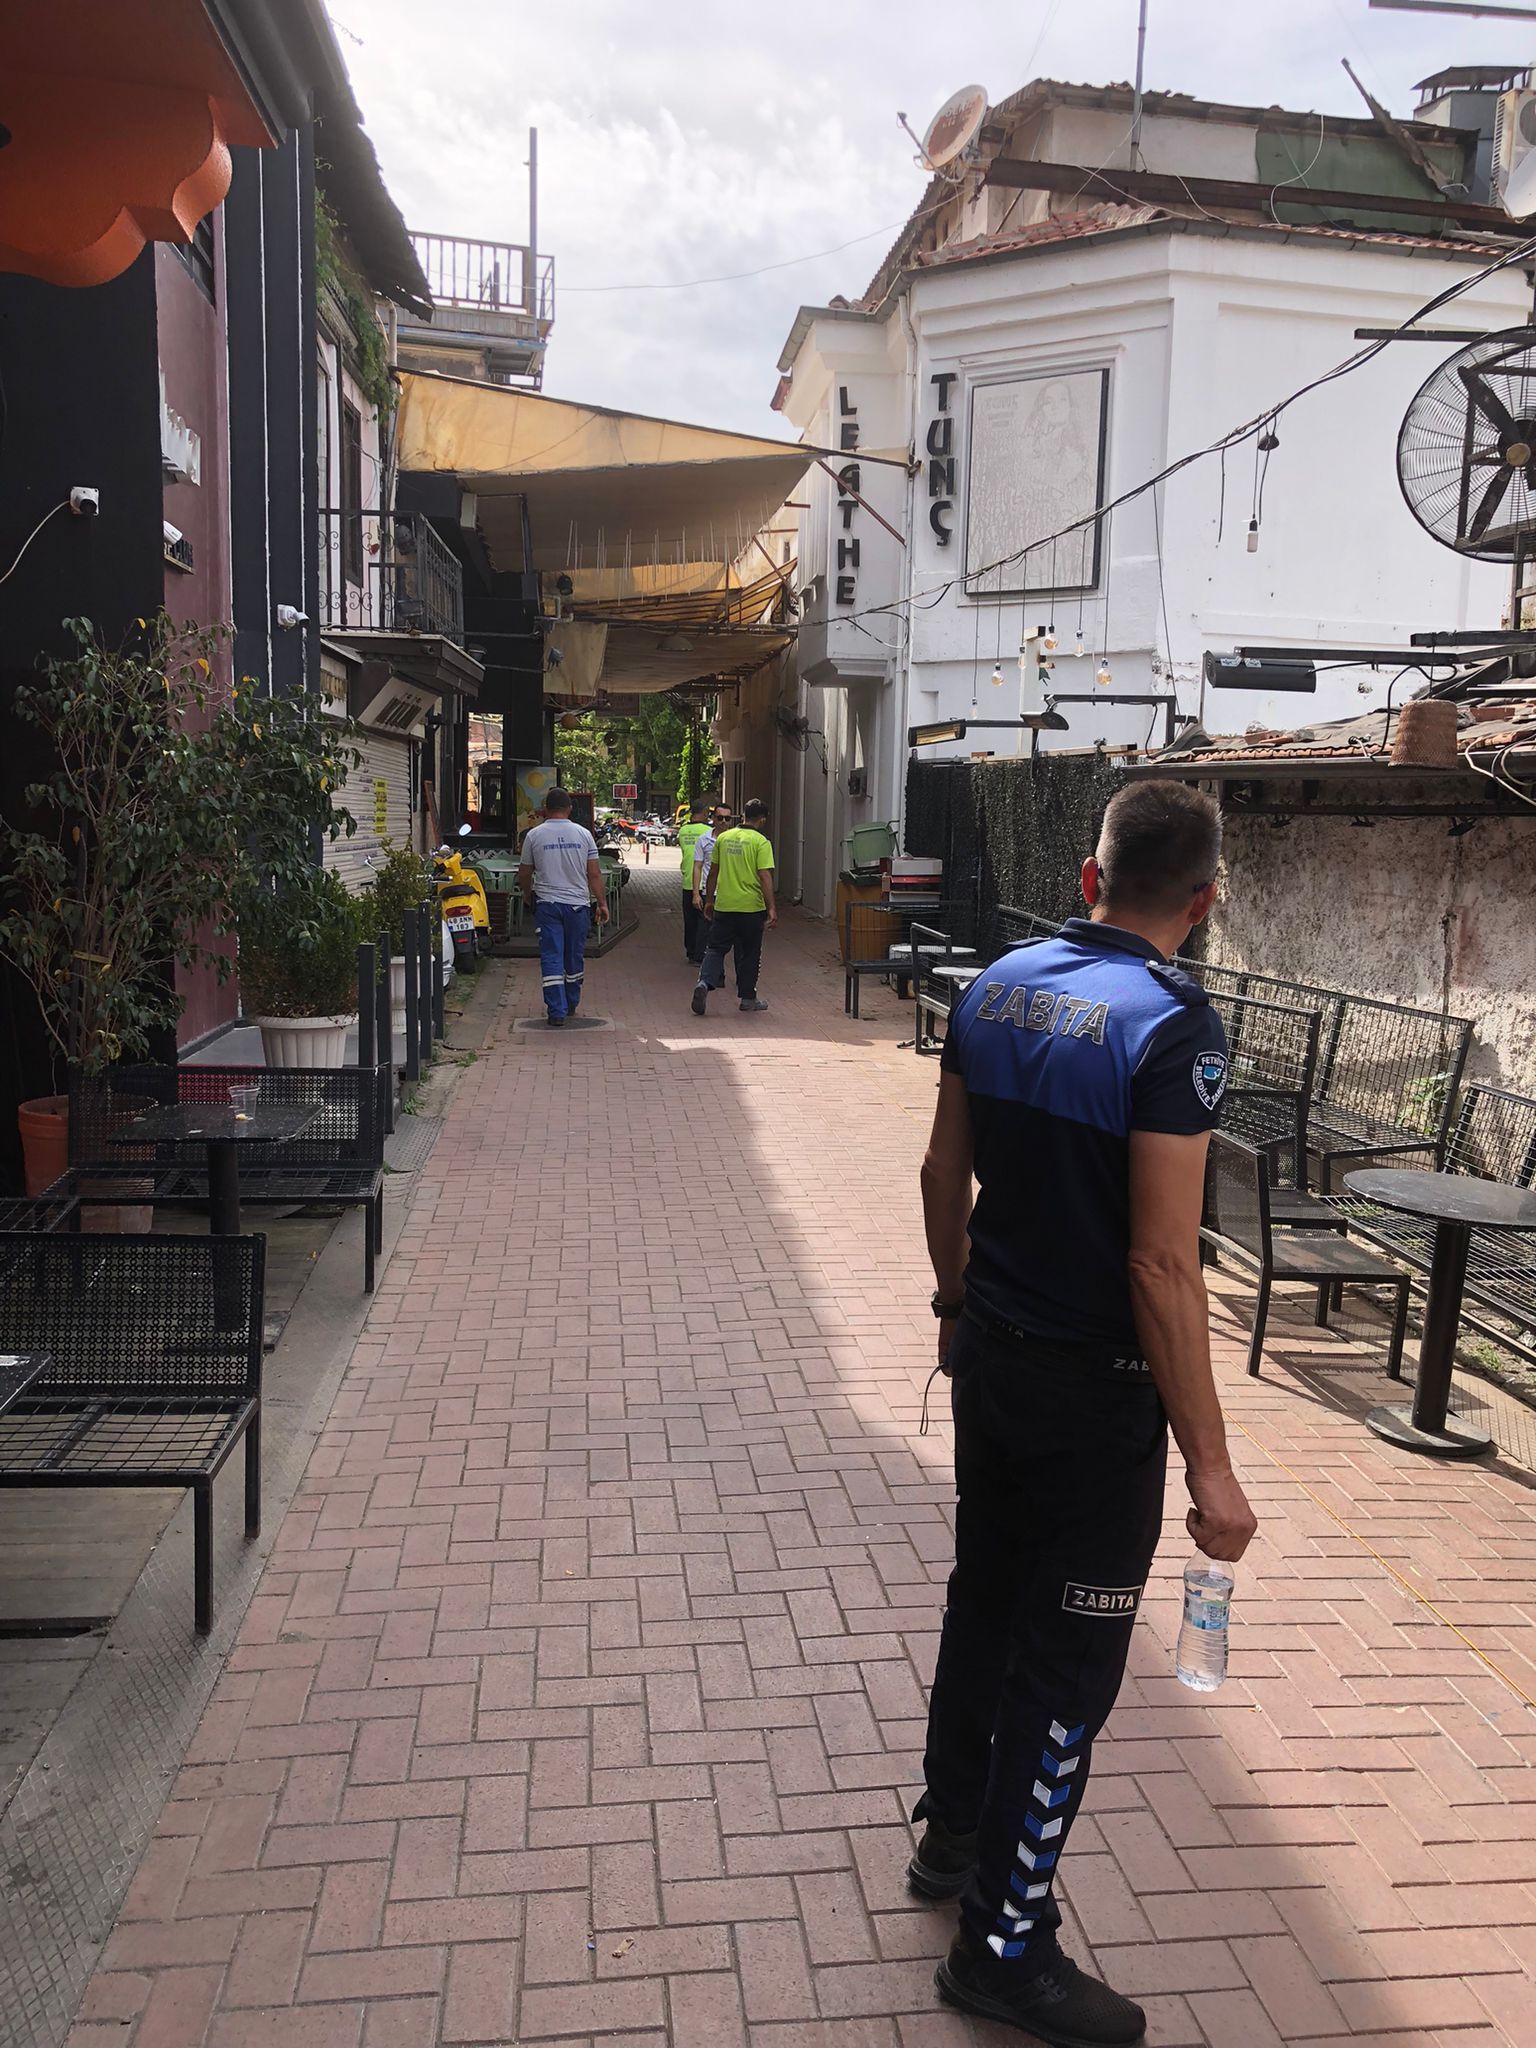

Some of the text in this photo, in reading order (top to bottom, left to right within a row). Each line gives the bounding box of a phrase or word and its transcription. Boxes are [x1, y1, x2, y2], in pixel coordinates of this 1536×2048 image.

[926, 372, 957, 547] TUNÇ
[976, 982, 1110, 1046] ZABITA
[1071, 1590, 1134, 1609] ZABITA
